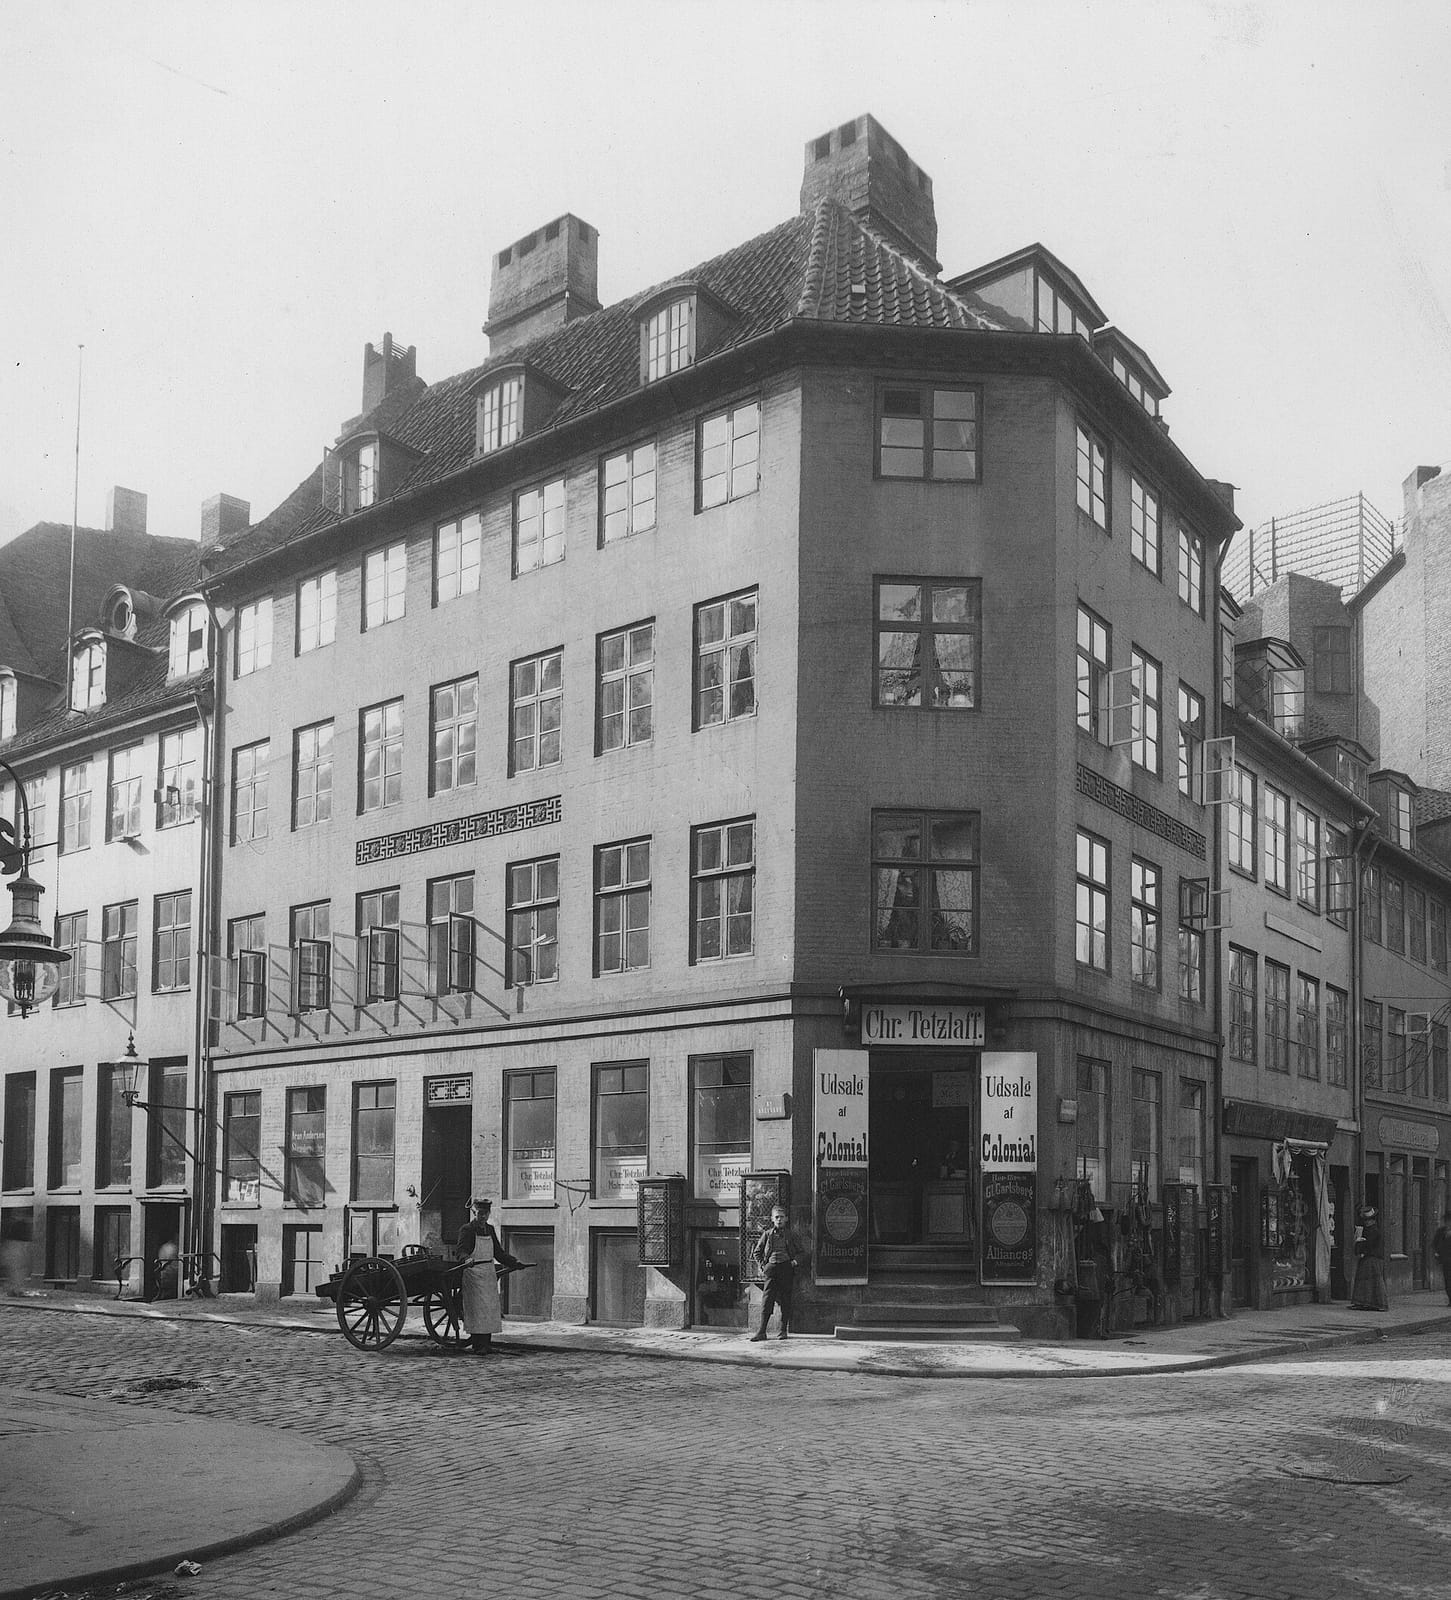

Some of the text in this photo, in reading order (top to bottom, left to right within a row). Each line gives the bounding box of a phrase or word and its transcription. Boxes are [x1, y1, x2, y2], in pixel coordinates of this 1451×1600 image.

[865, 1010, 983, 1039] Chr. Tetzlaff.
[820, 1073, 864, 1097] Udsalg
[985, 1076, 1032, 1099] Udsalg
[838, 1105, 847, 1118] af
[1003, 1106, 1014, 1120] af
[818, 1131, 869, 1162] Colonial
[982, 1133, 1036, 1164] Colonial
[534, 1170, 554, 1180] Tetzlaf
[995, 1181, 1033, 1199] Carlsberg
